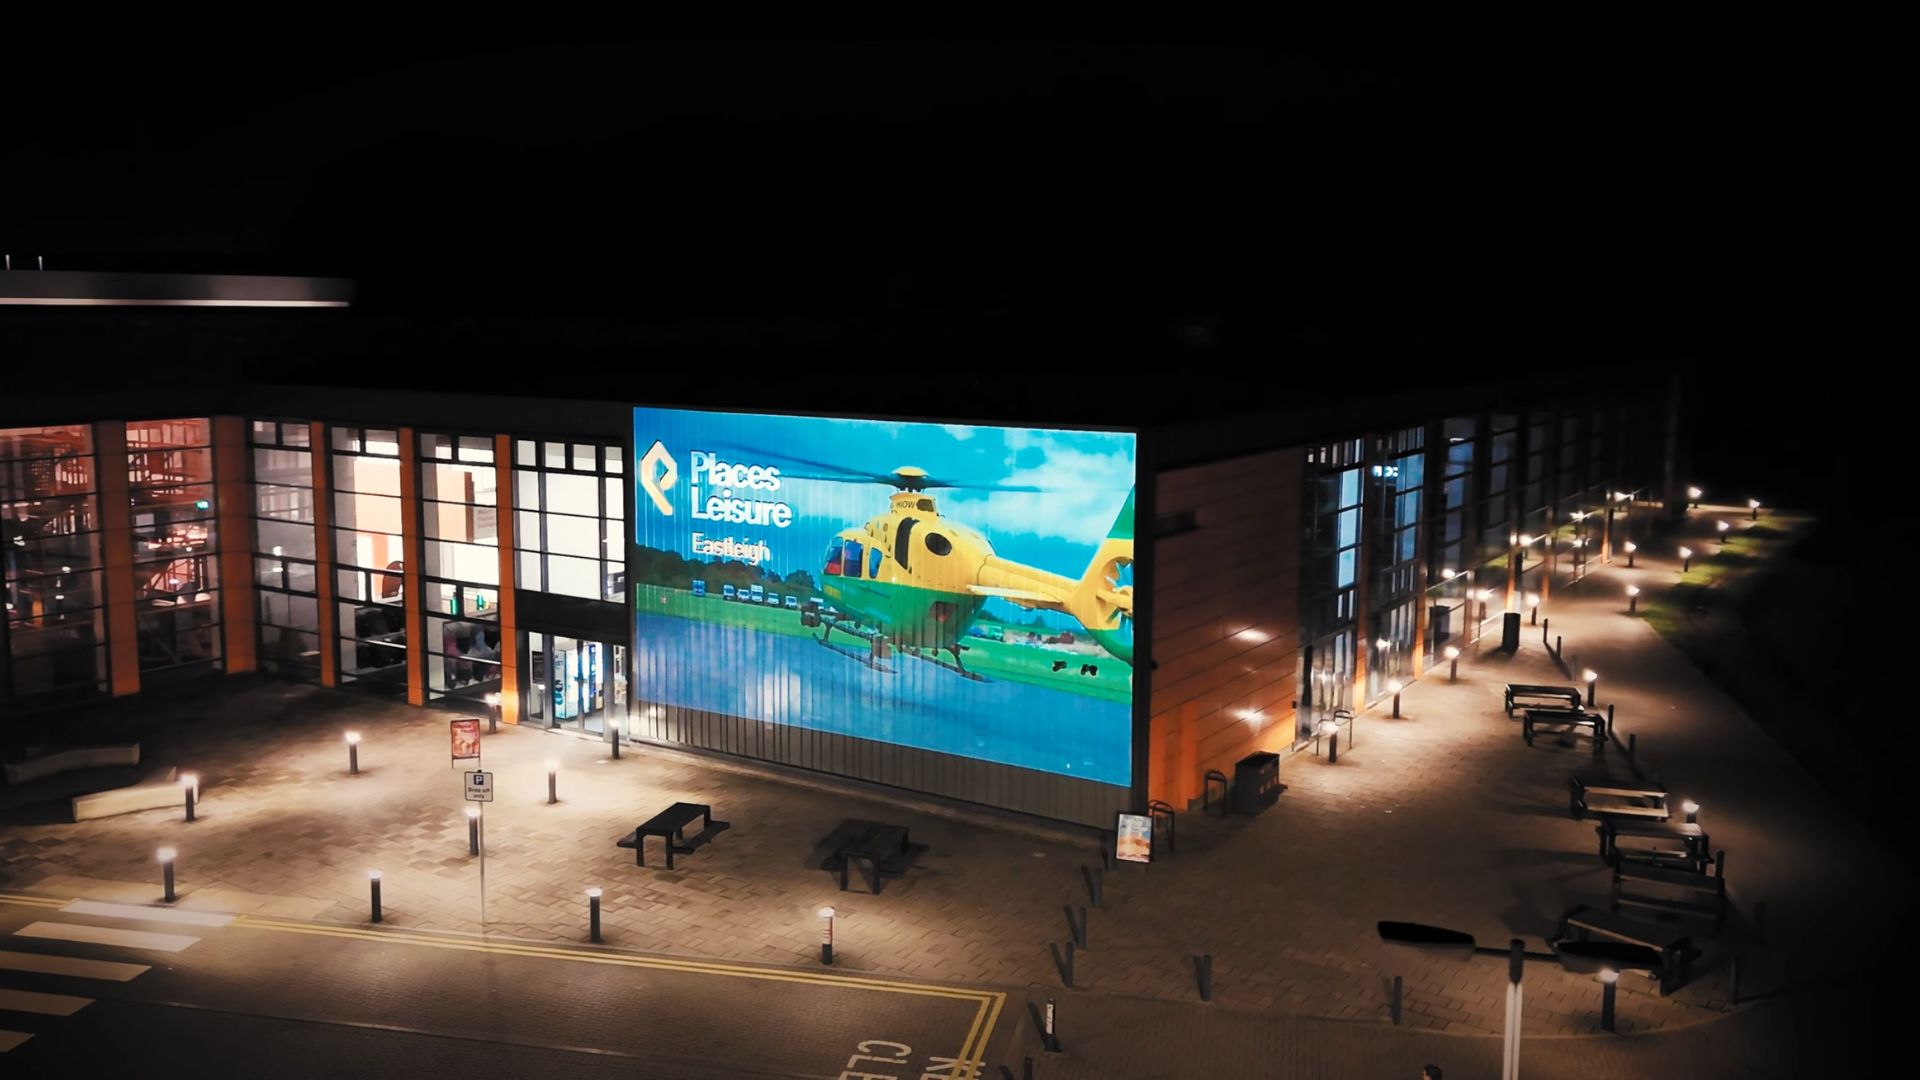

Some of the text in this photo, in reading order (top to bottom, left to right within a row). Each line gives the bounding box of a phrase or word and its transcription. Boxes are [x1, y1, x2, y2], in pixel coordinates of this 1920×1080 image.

[691, 451, 781, 491] Places
[691, 486, 793, 528] Leisure
[691, 532, 771, 566] Eastleigh
[475, 775, 483, 785] P
